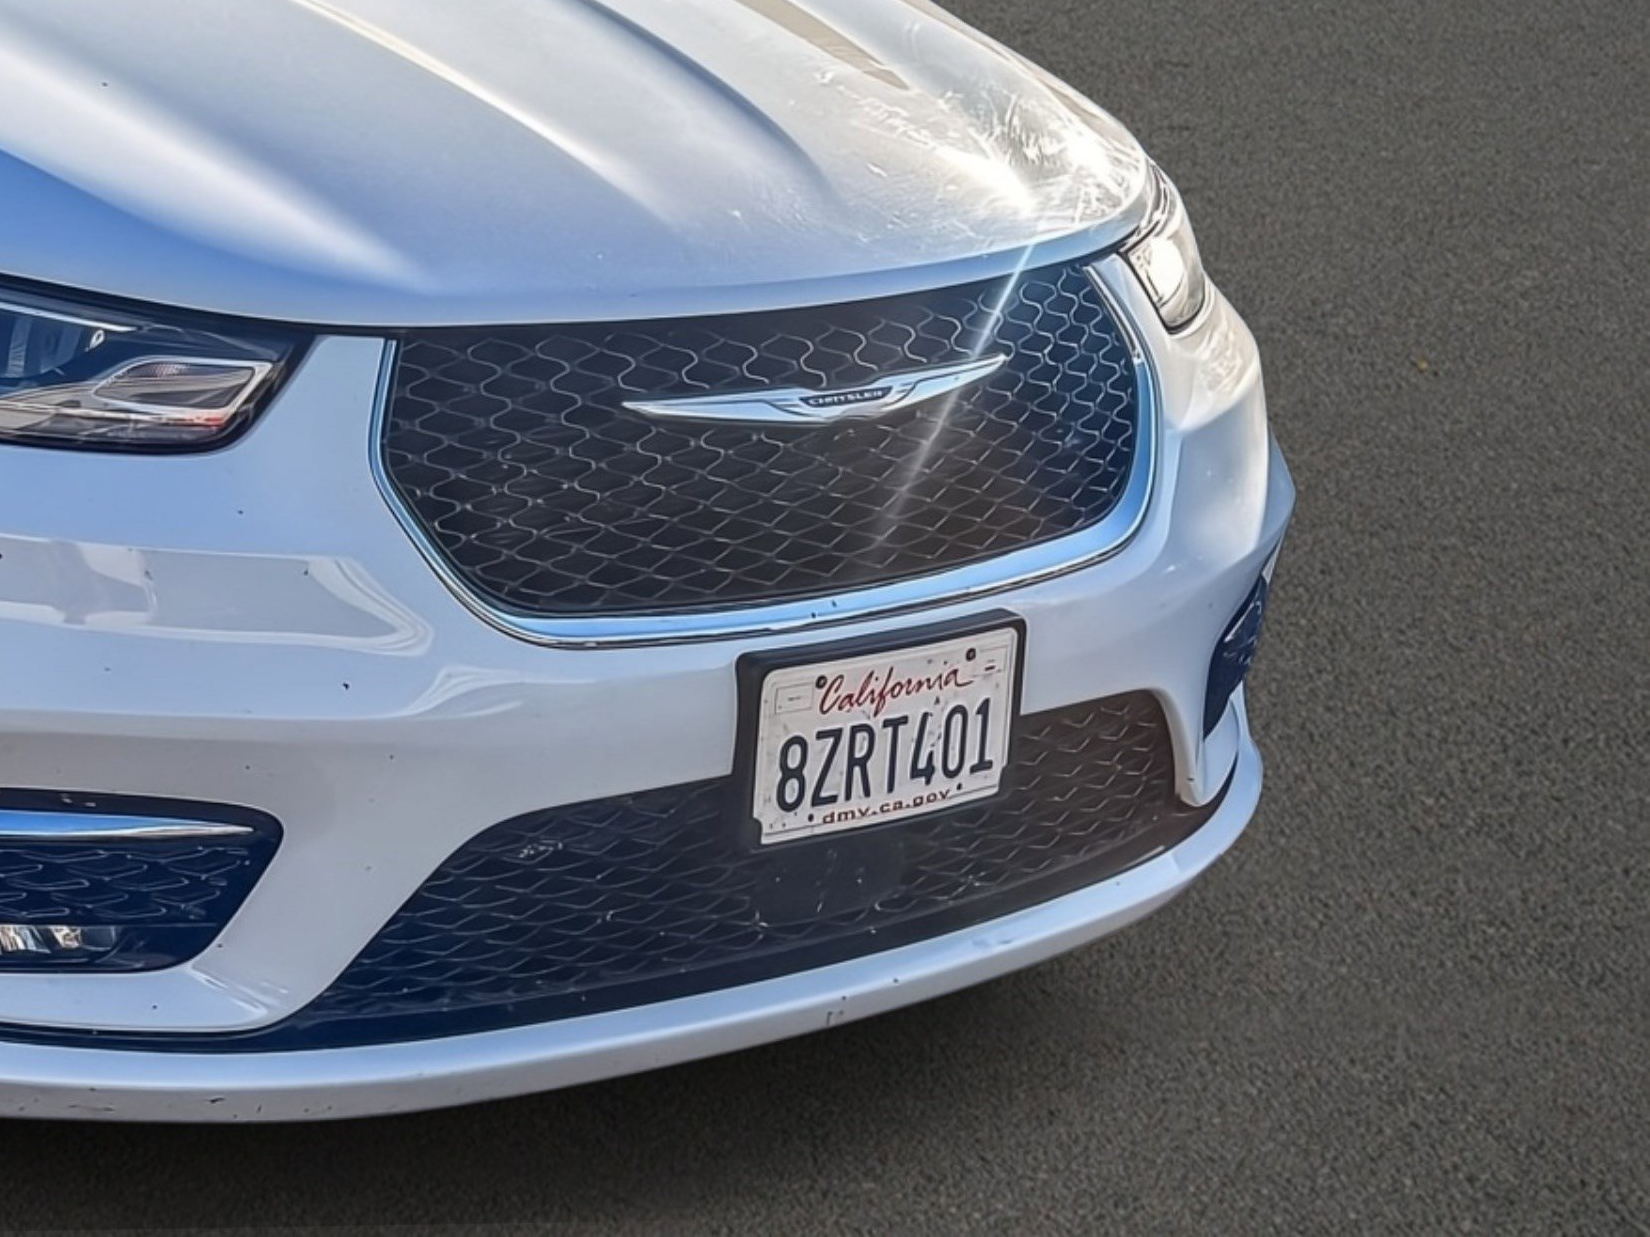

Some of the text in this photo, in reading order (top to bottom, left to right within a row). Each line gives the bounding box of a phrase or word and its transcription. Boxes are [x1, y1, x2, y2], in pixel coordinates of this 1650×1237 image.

[819, 666, 974, 718] California
[775, 697, 994, 813] 8ZRT401
[821, 788, 952, 825] dmv.ca.gov
